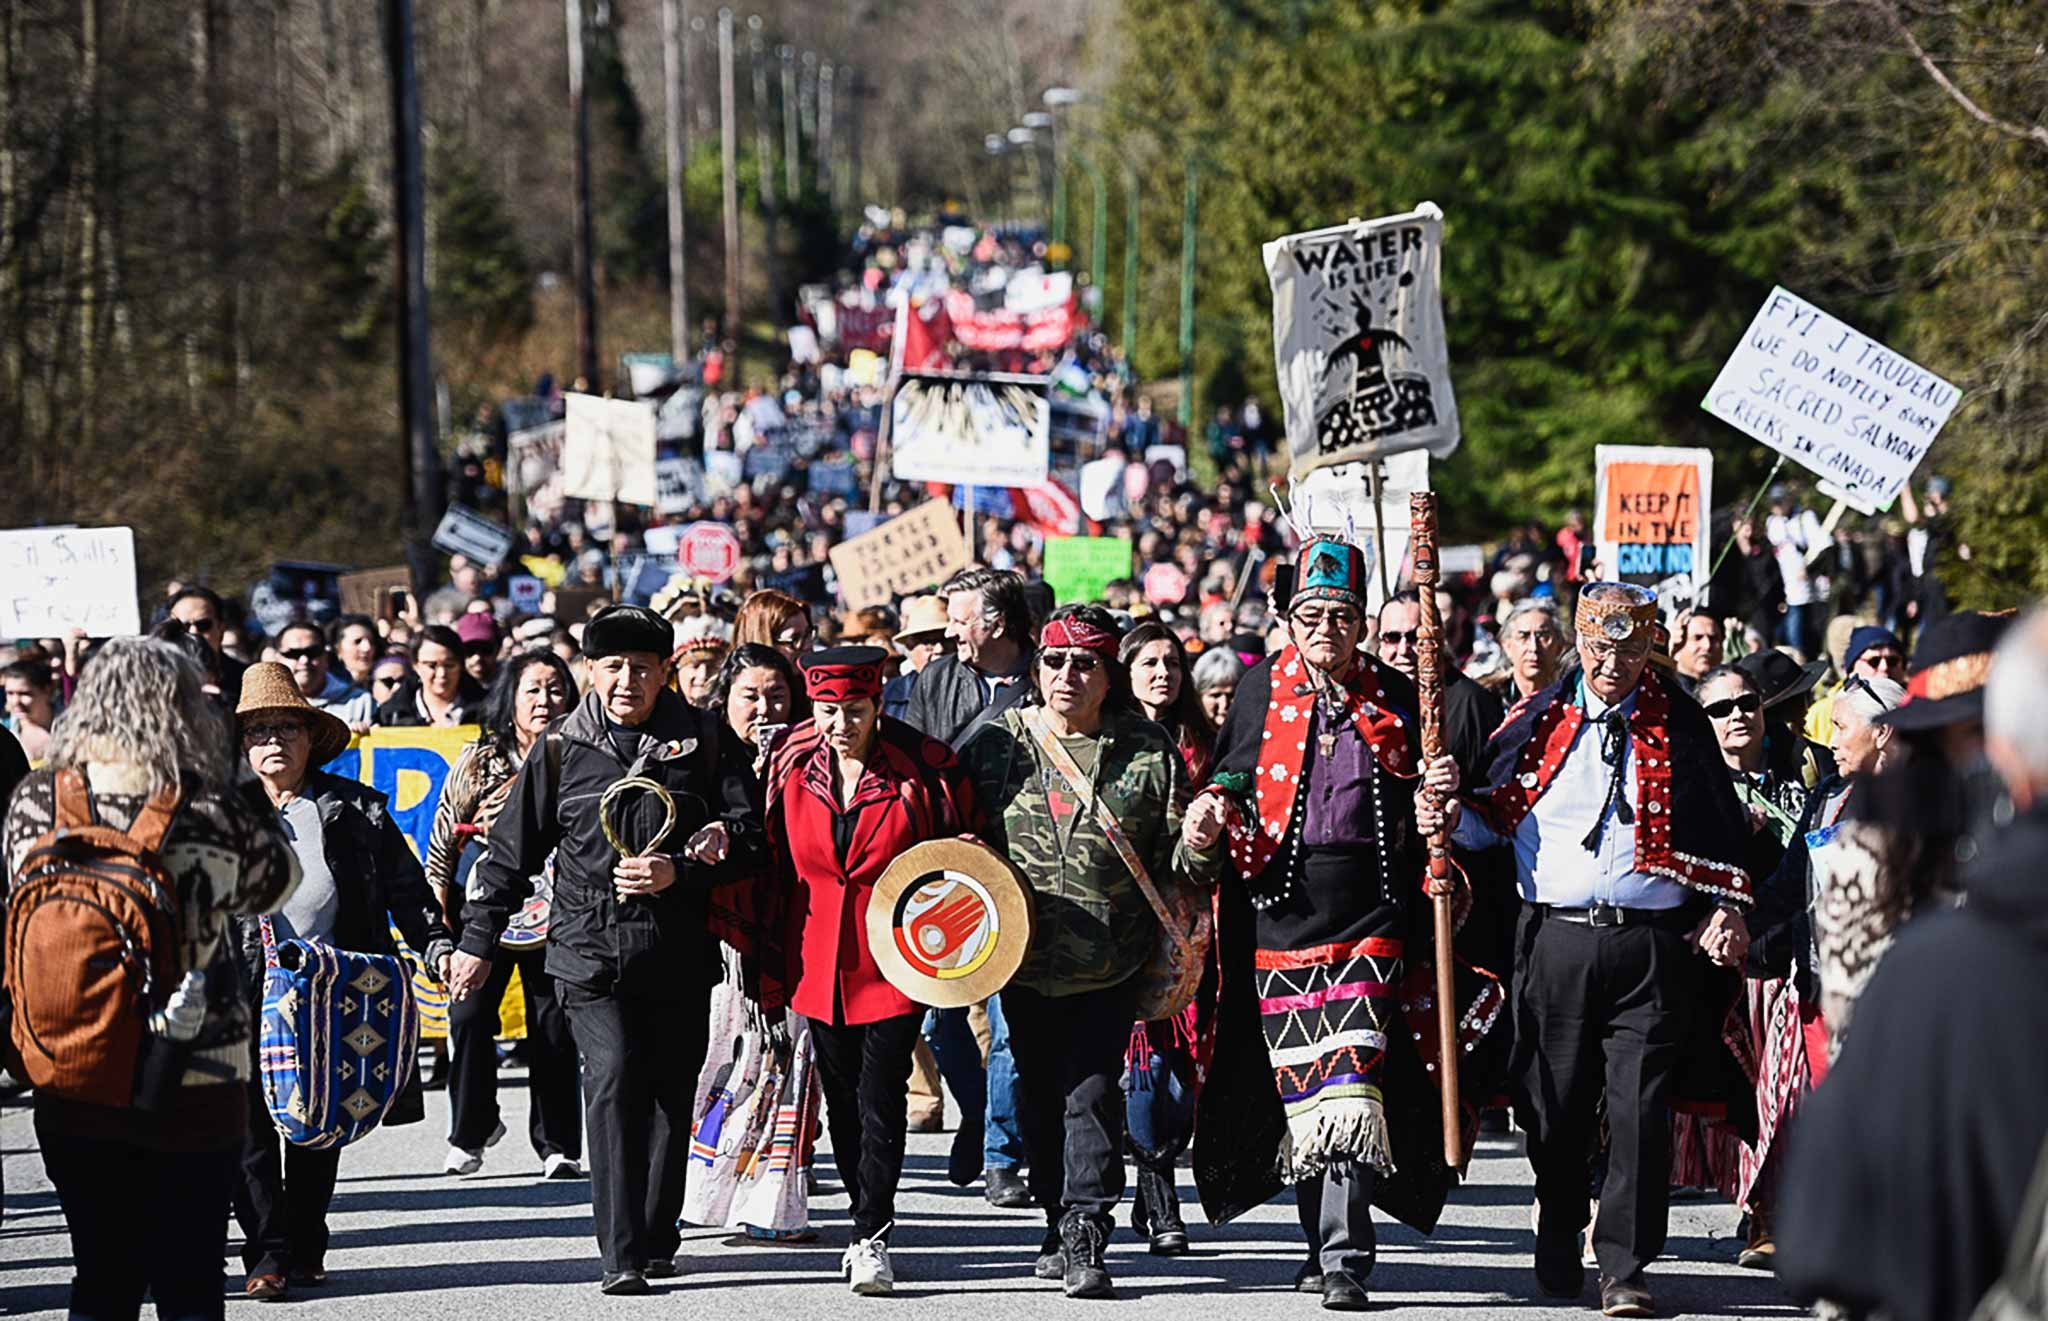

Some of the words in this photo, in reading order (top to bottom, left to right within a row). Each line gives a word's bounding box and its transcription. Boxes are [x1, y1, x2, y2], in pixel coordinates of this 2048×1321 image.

[1293, 226, 1423, 275] WATER
[1328, 272, 1349, 290] IS
[1354, 259, 1398, 285] LIFE
[1750, 327, 1787, 358] WE
[1791, 349, 1820, 373] DO
[1767, 295, 1822, 337] FYI
[1856, 343, 1953, 409] TRUDEAU
[1715, 390, 1792, 444] CREEKS
[1792, 435, 1816, 454] IN
[1750, 368, 1842, 425] SACRED
[1844, 415, 1924, 463] SALMON
[1619, 493, 1670, 515] KEEP
[1619, 521, 1641, 538] IN
